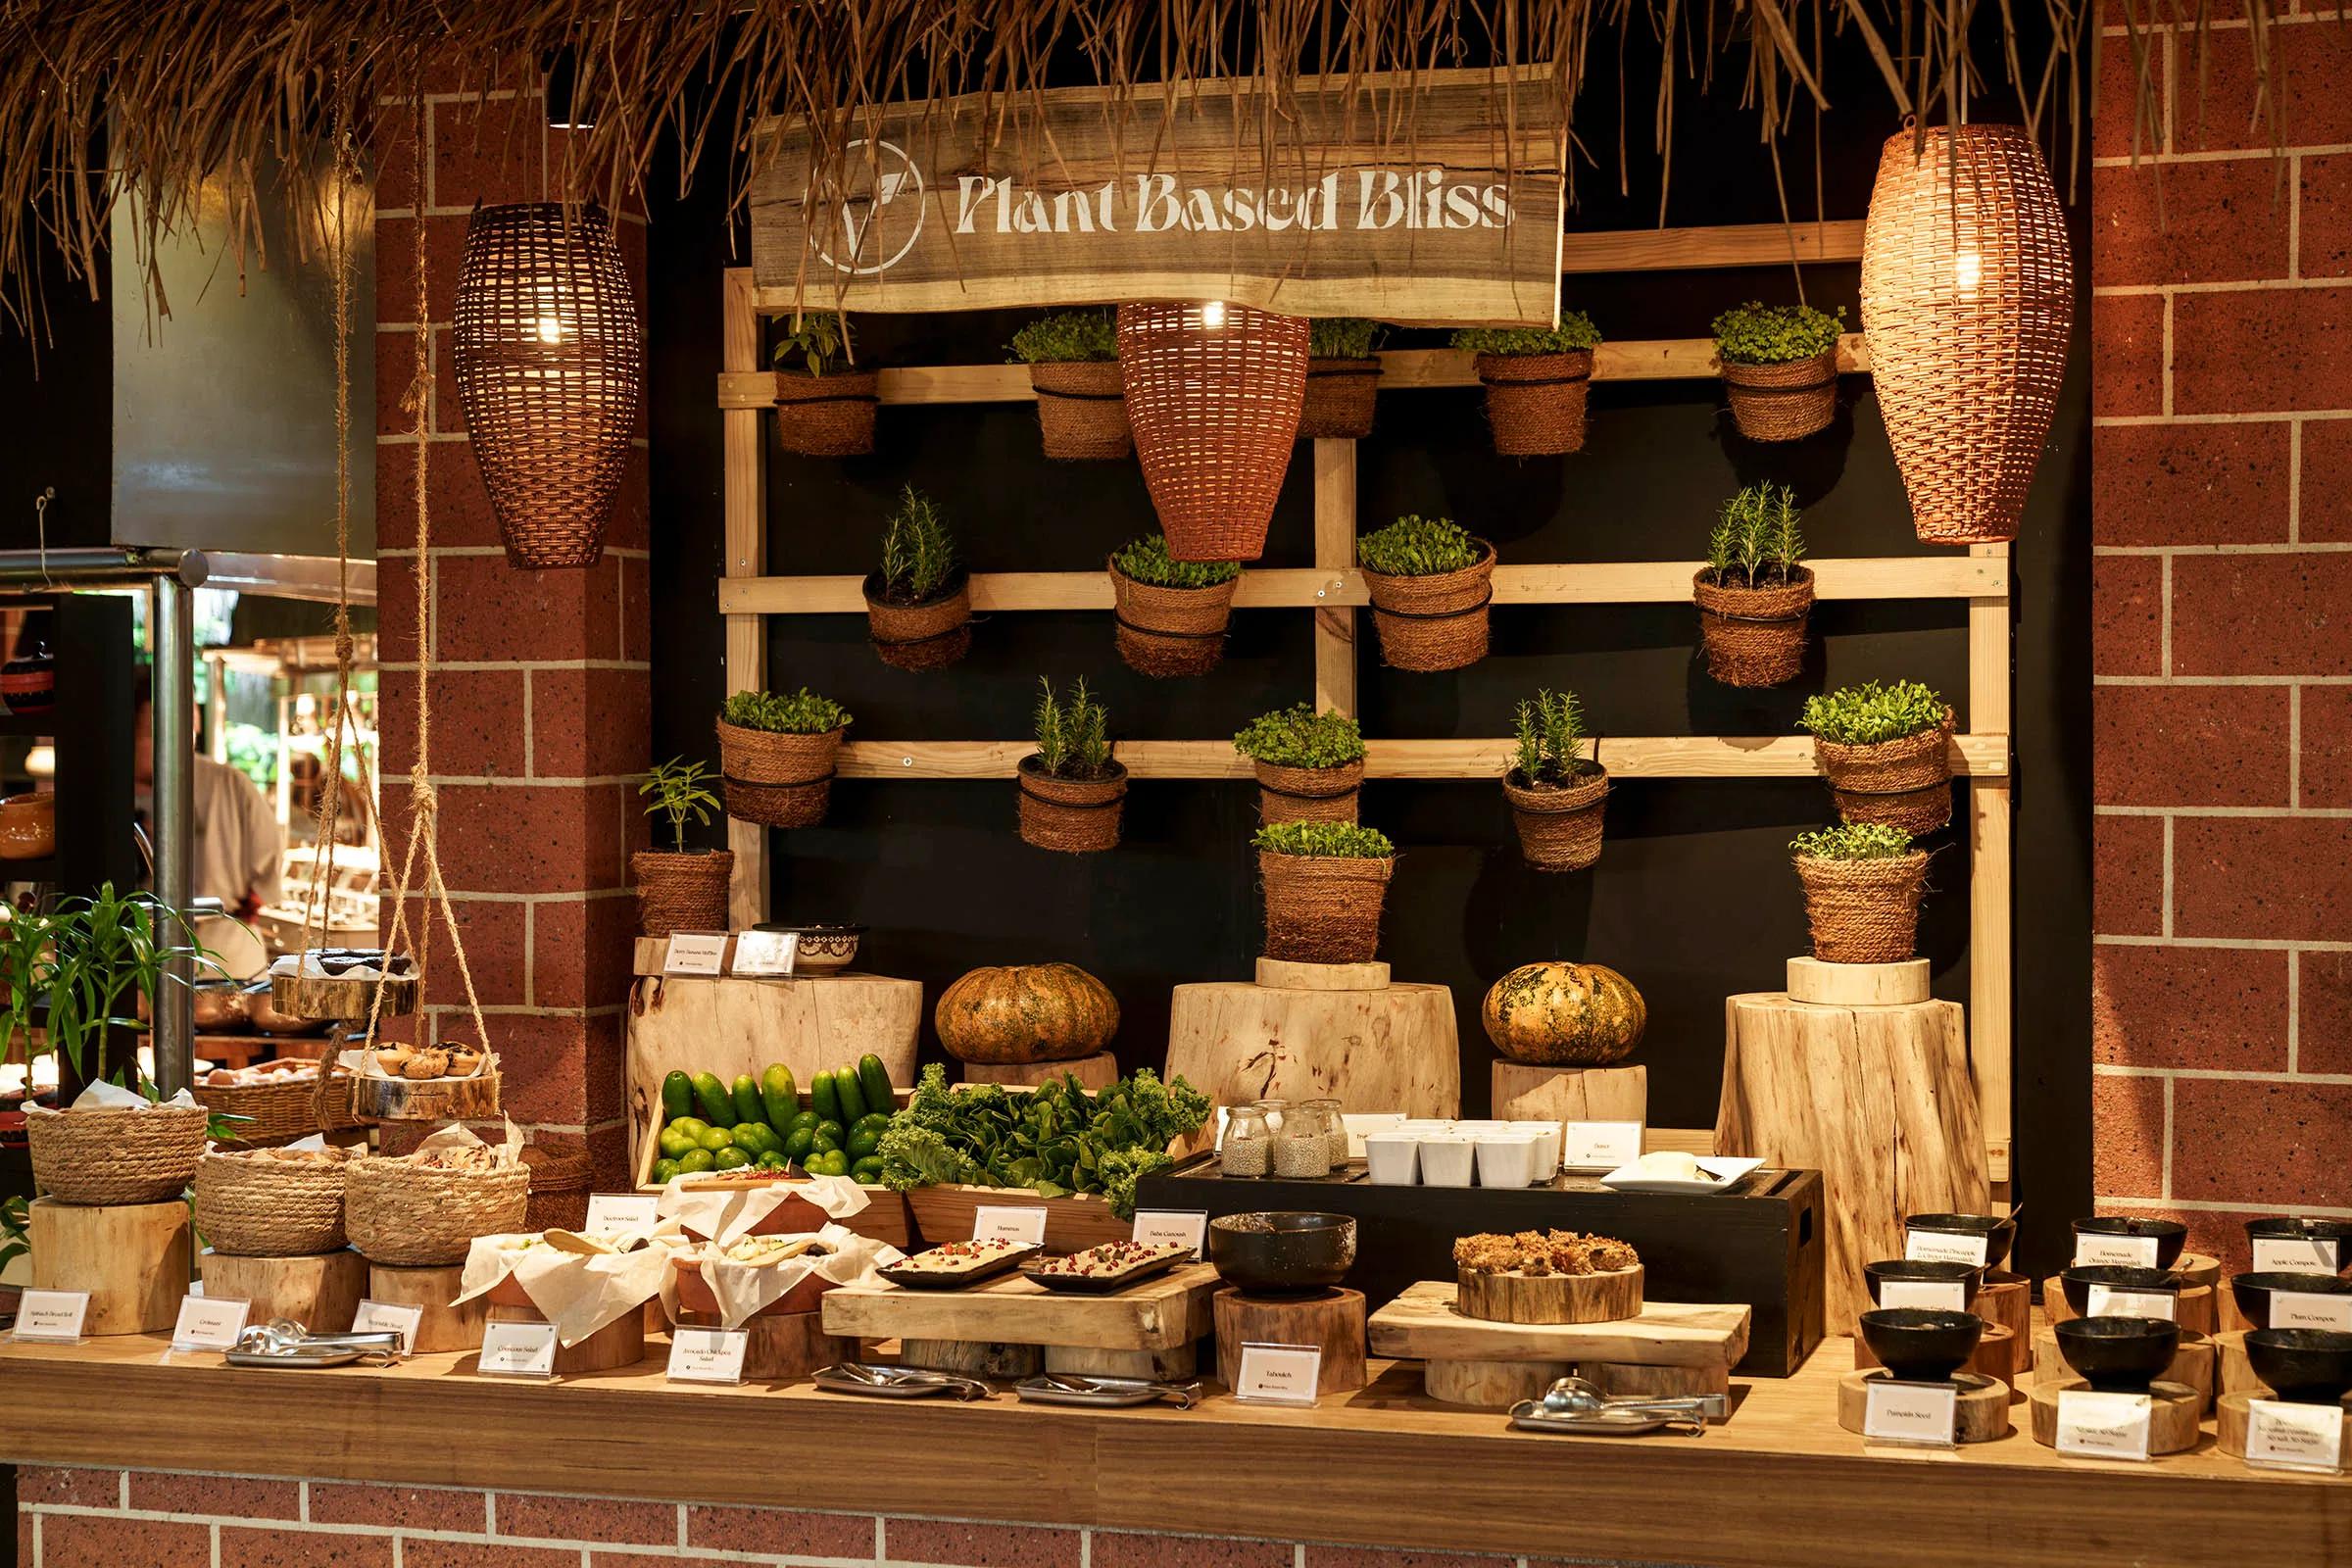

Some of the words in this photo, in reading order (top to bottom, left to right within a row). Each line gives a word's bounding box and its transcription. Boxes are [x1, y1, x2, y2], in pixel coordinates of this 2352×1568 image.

[956, 174, 1118, 234] Plant
[1134, 171, 1340, 232] Based
[1356, 169, 1516, 230] Bliss
[2307, 1314, 2337, 1323] Compote
[1886, 1409, 1914, 1418] Pumpkin
